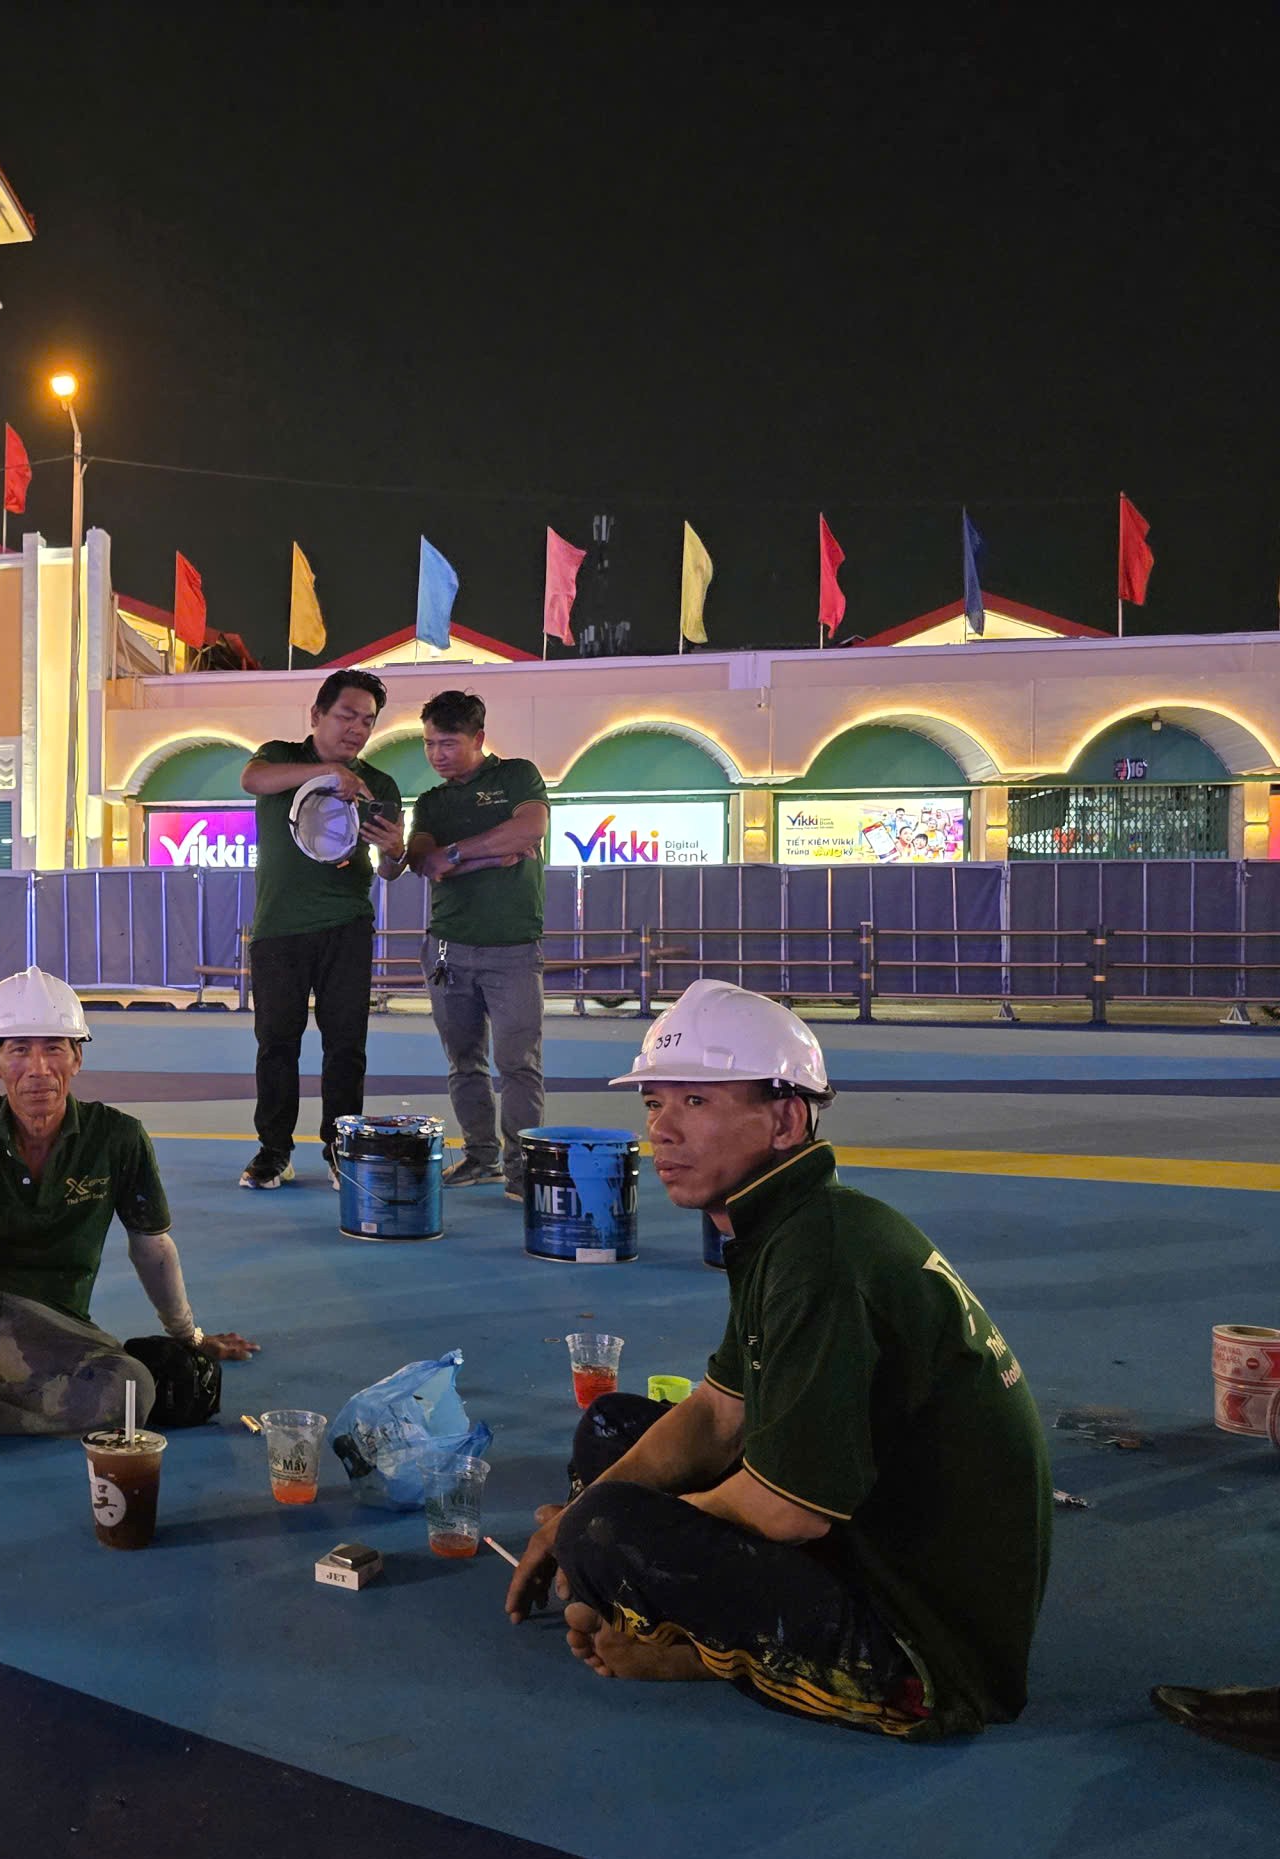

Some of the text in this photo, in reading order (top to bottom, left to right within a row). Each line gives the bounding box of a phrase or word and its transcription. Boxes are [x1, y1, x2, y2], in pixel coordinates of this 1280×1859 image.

[787, 810, 818, 826] Vikki
[160, 819, 245, 867] Vikki
[564, 814, 699, 862] Vikki Digital
[665, 850, 708, 863] Bank
[656, 1033, 683, 1050] 397
[326, 1572, 347, 1583] JET
